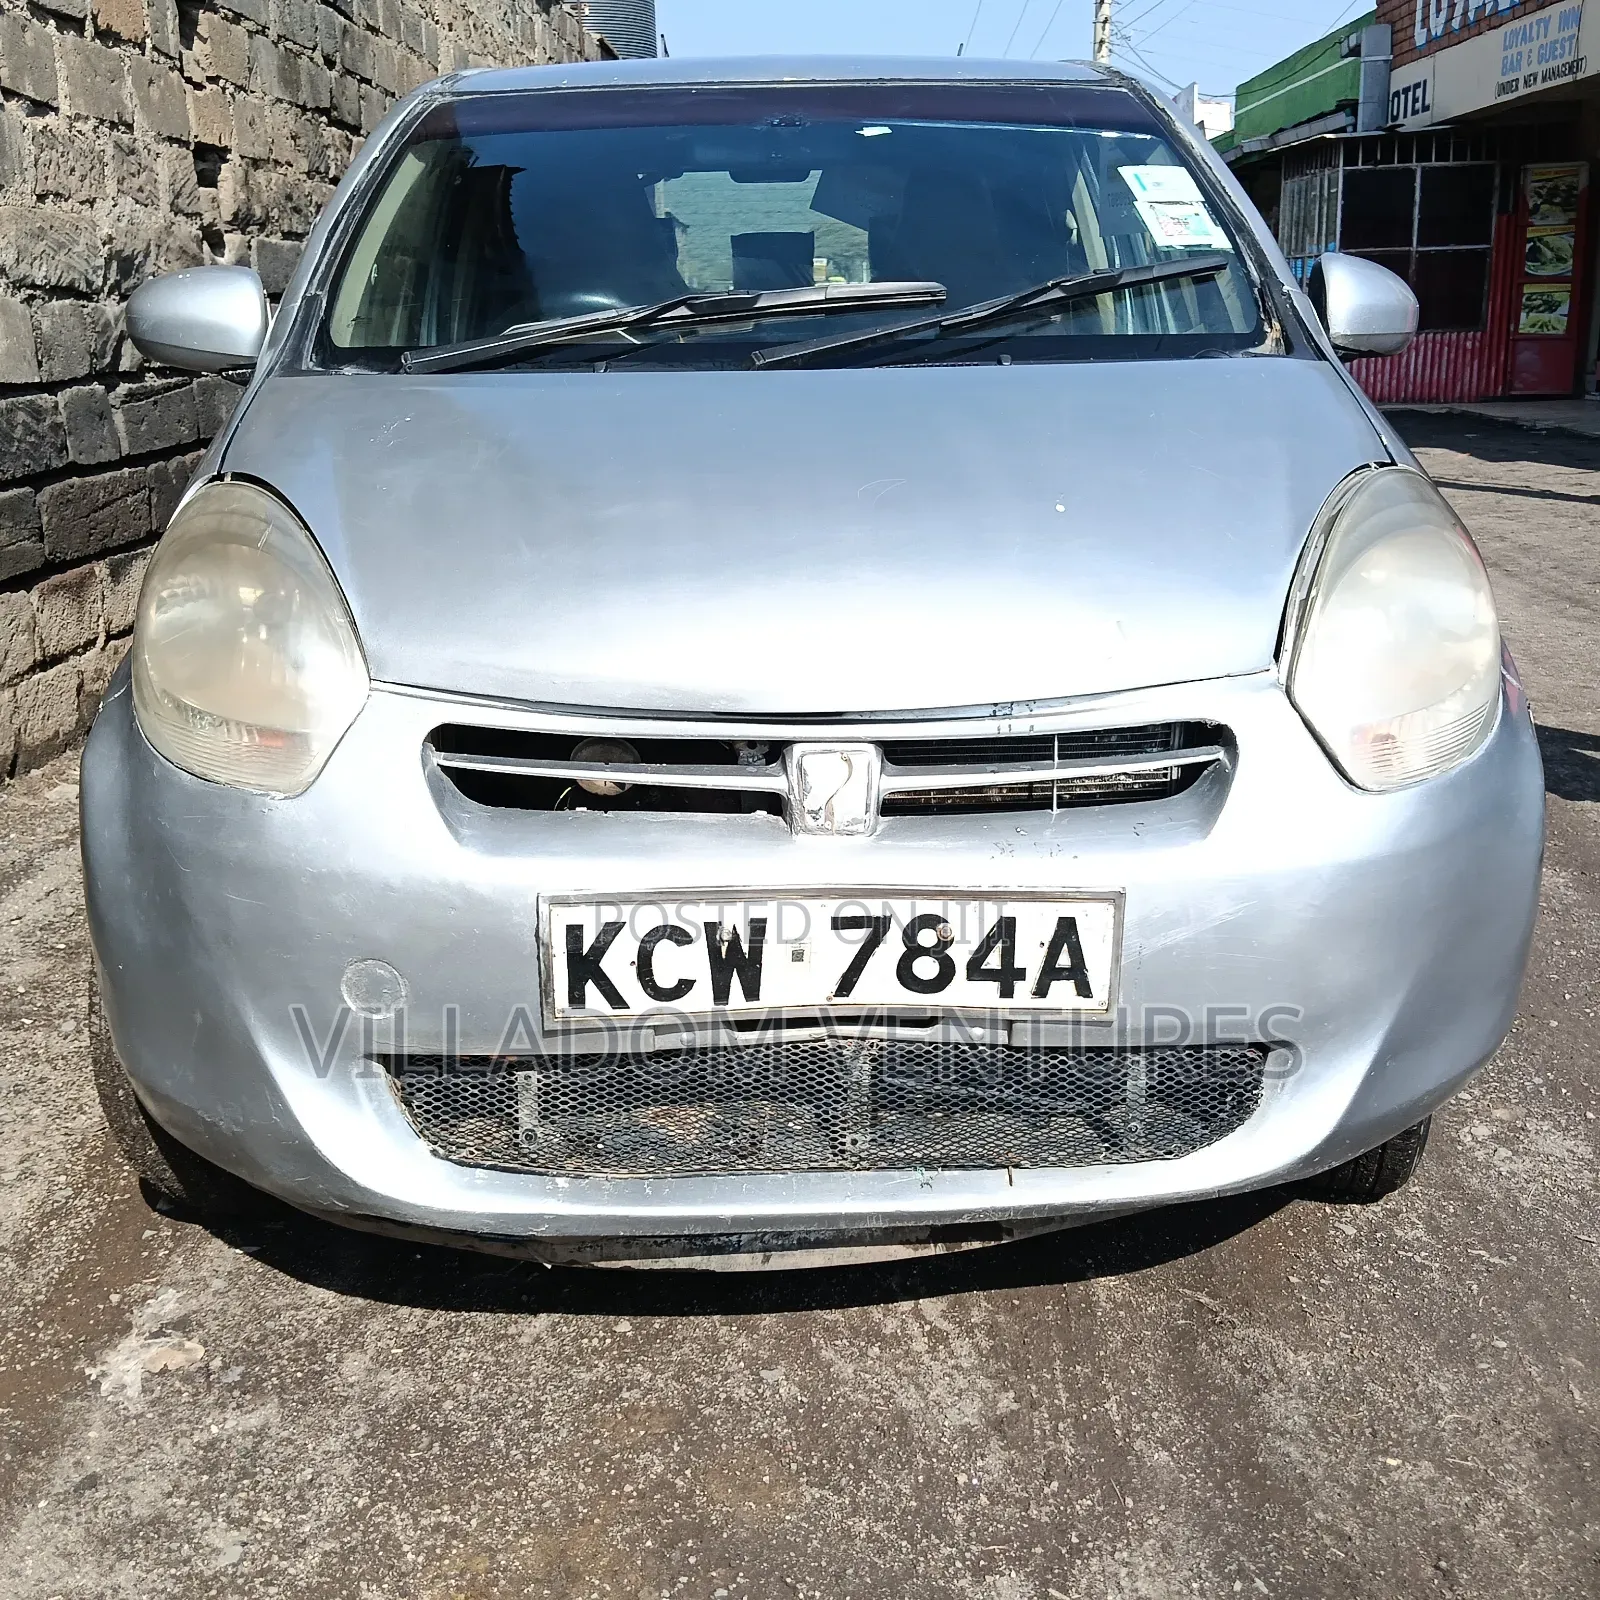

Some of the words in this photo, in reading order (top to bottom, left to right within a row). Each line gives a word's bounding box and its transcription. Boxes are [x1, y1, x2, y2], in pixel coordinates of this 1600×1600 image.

[1503, 15, 1552, 51] LOYALTY
[1558, 5, 1581, 33] INN
[1501, 51, 1523, 76] BAR
[1537, 33, 1576, 65] GUEST
[1495, 77, 1520, 99] (UNDER
[1523, 71, 1539, 89] NEW
[1541, 55, 1588, 84] MANAGEMENT)
[1390, 79, 1431, 123] OTEL
[564, 917, 768, 1010] KCW
[830, 913, 1094, 1000] 784A
